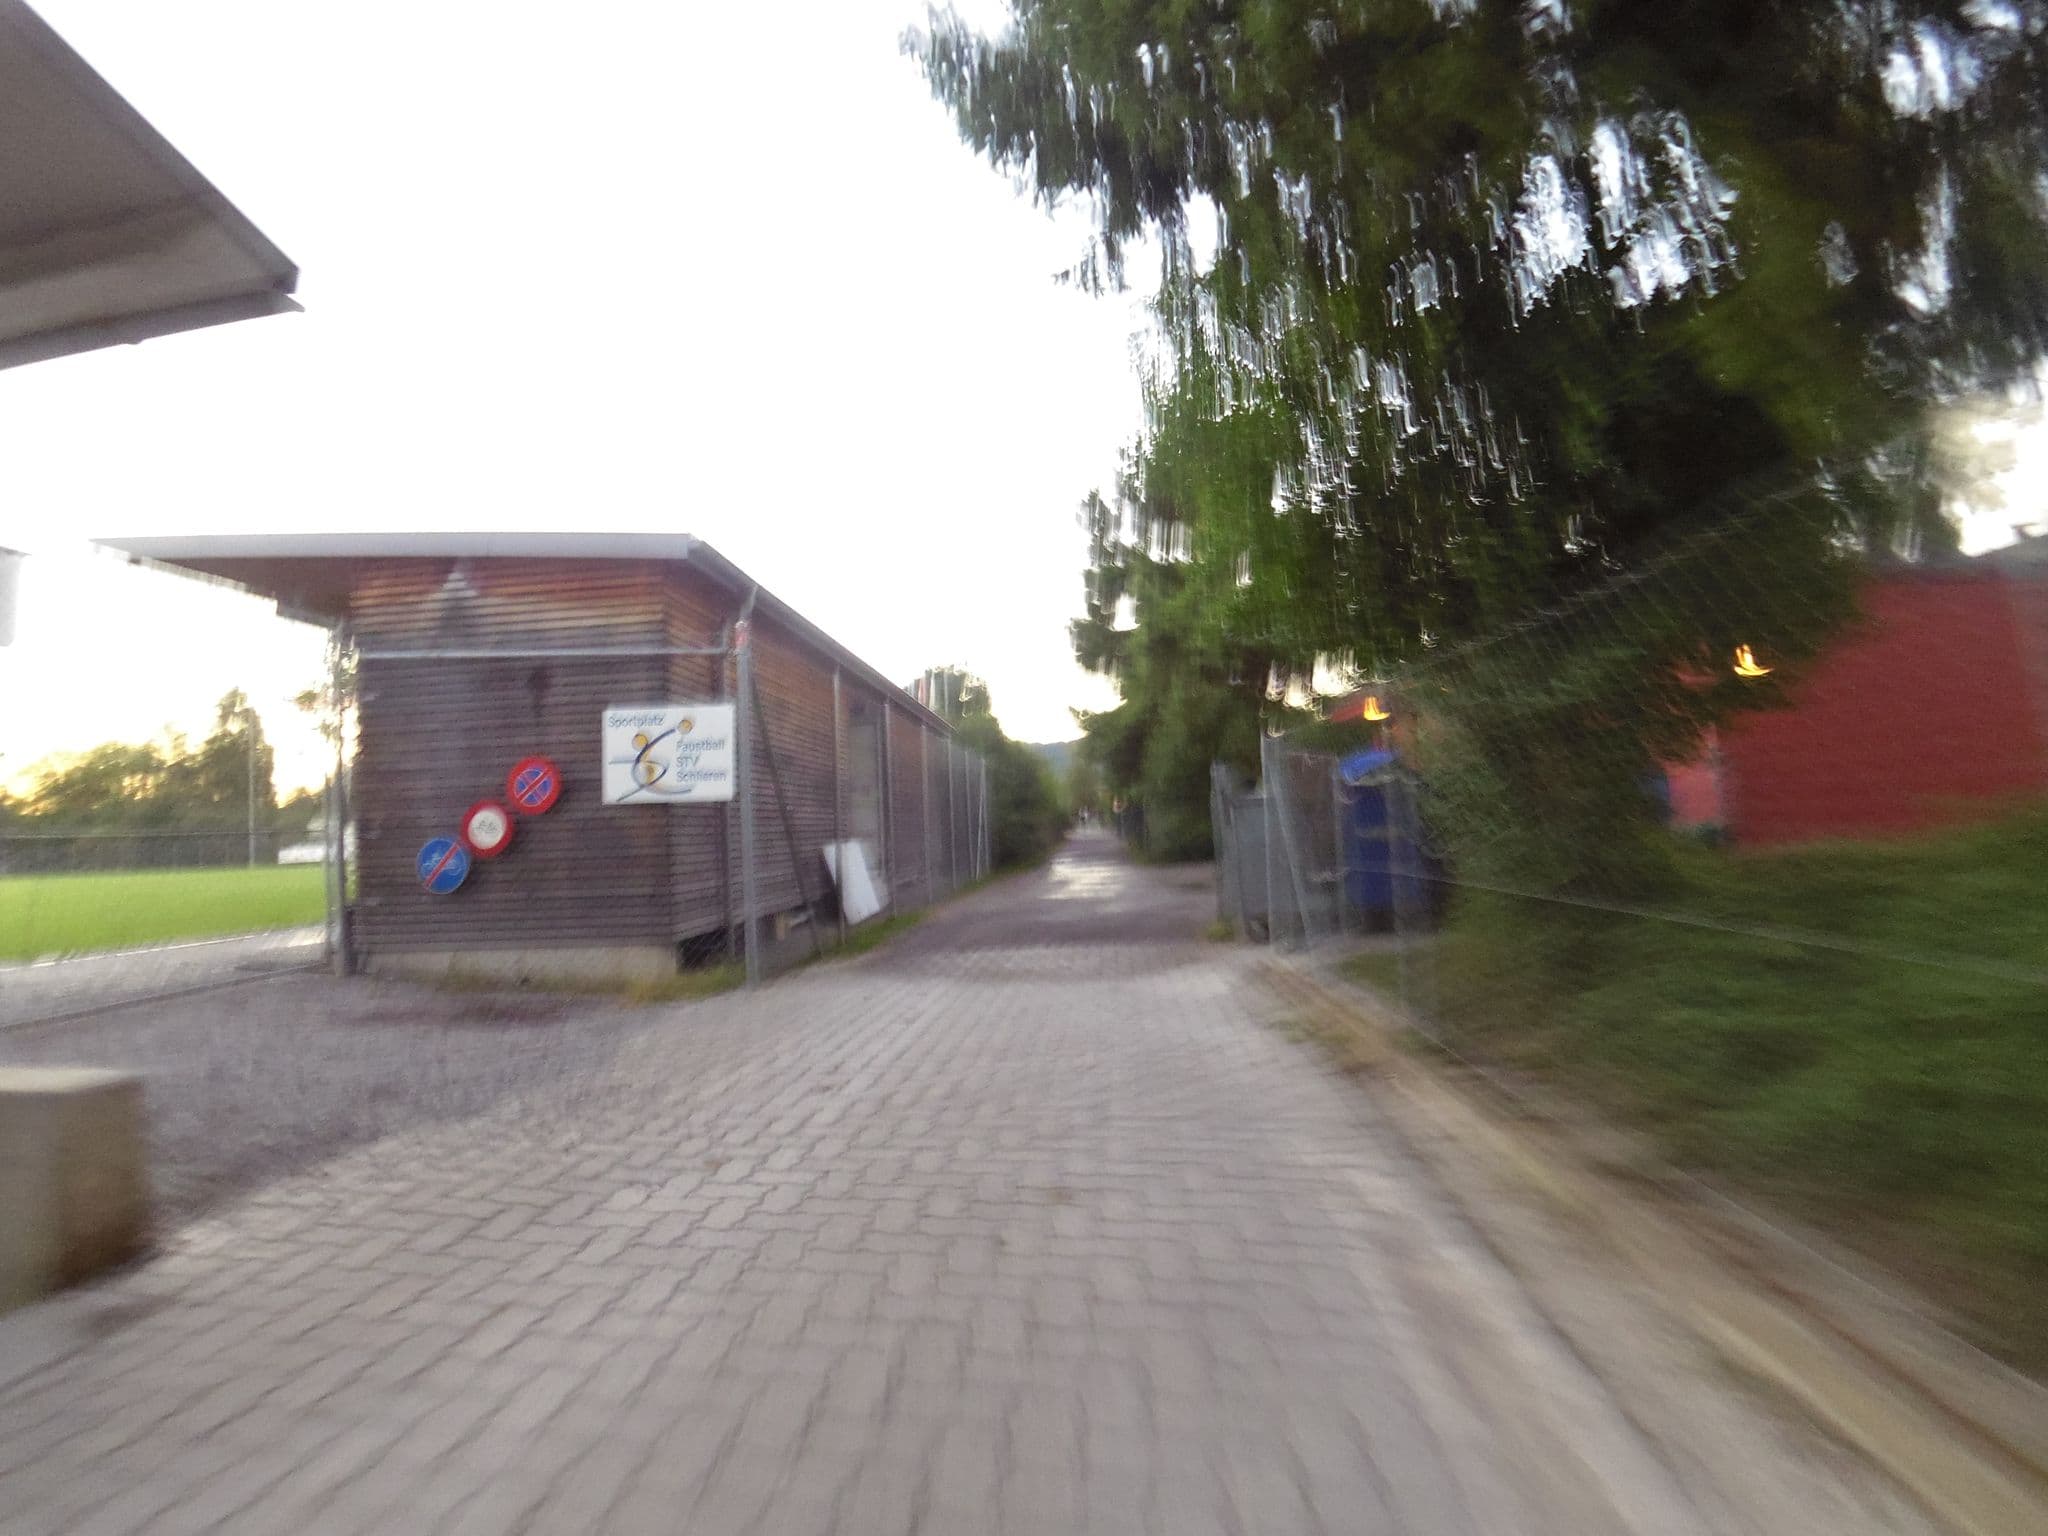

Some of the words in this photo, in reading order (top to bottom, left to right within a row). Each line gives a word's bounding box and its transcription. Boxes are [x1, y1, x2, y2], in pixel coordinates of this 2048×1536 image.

[608, 713, 665, 729] Sportplatz
[676, 738, 725, 752] Faustball
[676, 756, 699, 768] STV
[676, 769, 727, 782] Schlieren
